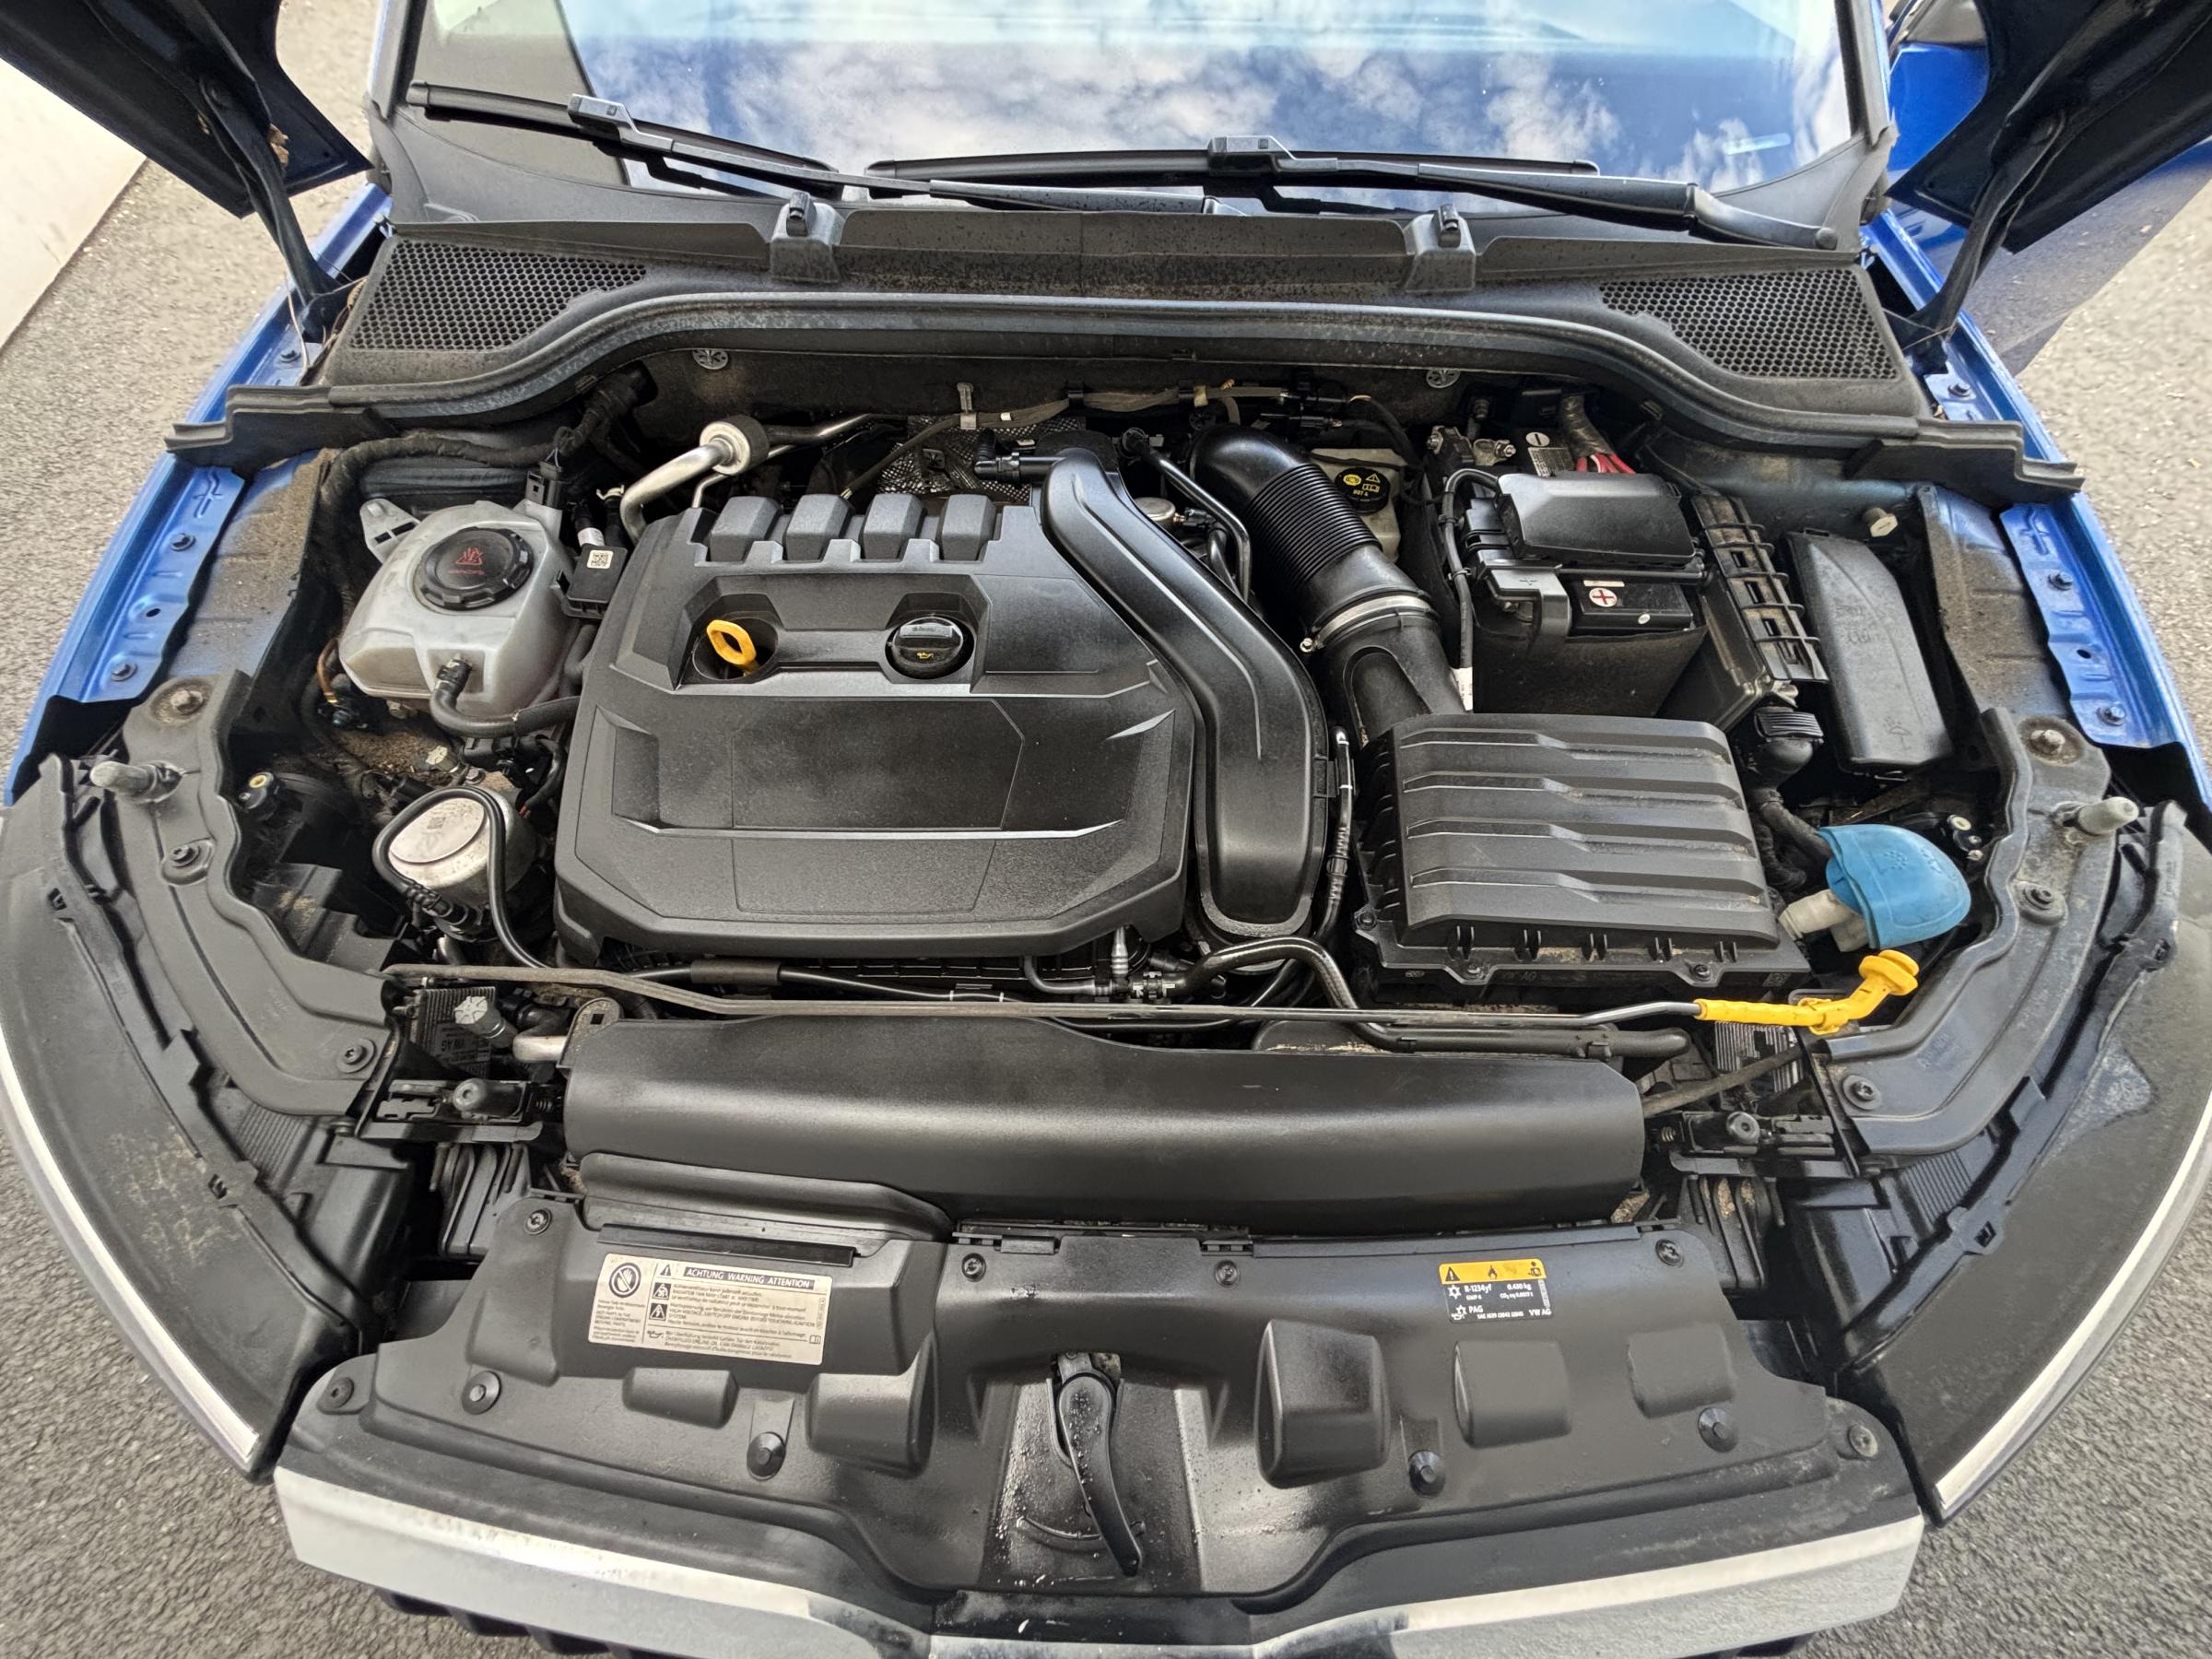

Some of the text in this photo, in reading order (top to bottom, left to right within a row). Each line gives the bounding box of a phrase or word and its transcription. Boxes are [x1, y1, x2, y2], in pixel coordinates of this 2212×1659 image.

[686, 1268, 811, 1288] ACHTUNG WARNING ATTENTION
[1464, 1284, 1492, 1294] R-1234yf
[1523, 1282, 1532, 1291] kg
[1468, 1305, 1484, 1313] PAG
[1541, 1308, 1552, 1316] AG
